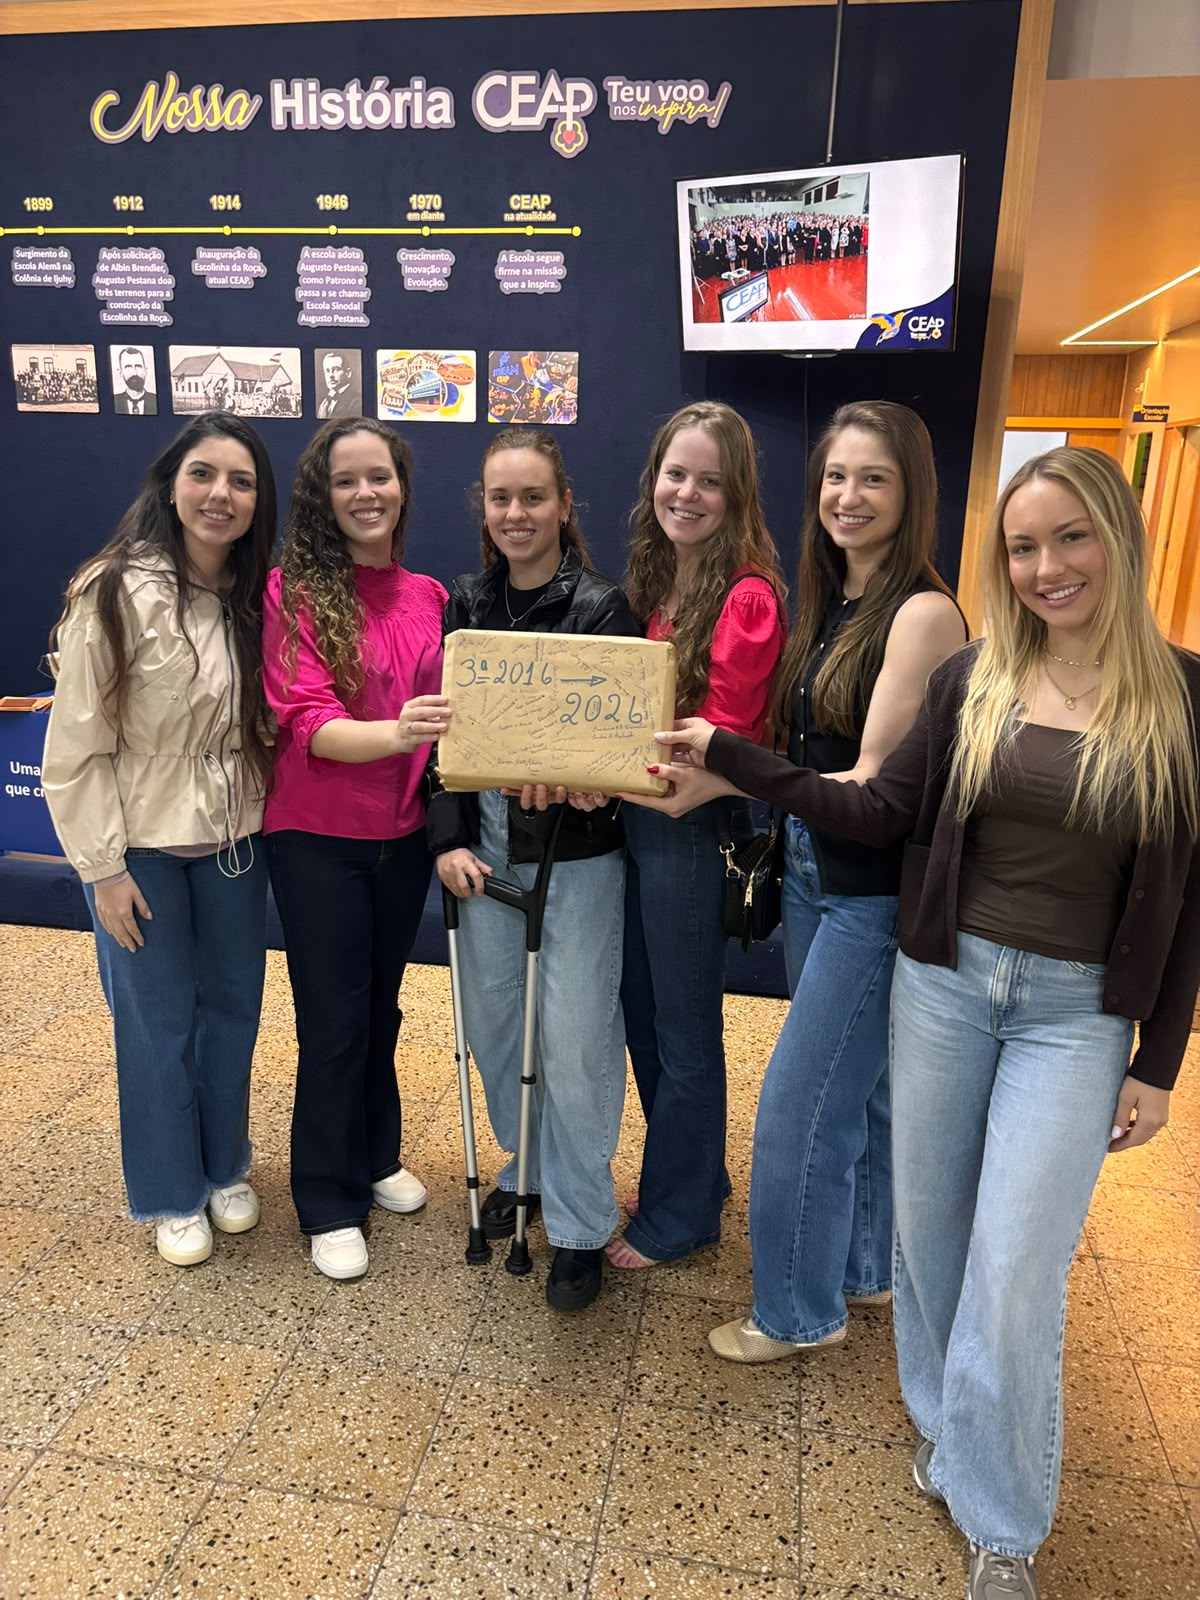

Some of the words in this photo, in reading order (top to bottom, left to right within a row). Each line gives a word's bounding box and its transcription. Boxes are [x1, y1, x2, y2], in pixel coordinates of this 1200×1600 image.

[607, 81, 650, 102] Teu
[658, 84, 705, 102] voo
[92, 74, 261, 141] Nossa
[273, 79, 452, 126] História
[475, 74, 594, 132] CEAP
[613, 105, 637, 115] nos
[638, 86, 728, 130] inspira!
[24, 197, 53, 211] 1899
[113, 195, 144, 211] 1912
[209, 194, 241, 211] 1914
[316, 194, 348, 210] 1946
[409, 194, 442, 210] 1970
[509, 194, 551, 210] CEAP
[406, 212, 420, 221] em
[421, 211, 445, 221] diante
[503, 213, 515, 221] na
[516, 211, 556, 221] atualidade
[15, 249, 57, 259] Surgimento
[59, 250, 68, 258] da
[102, 250, 121, 260] Após
[122, 251, 162, 261] solicitação
[199, 250, 246, 260] Inauguração
[247, 250, 258, 259] da
[303, 250, 310, 259] A
[311, 250, 336, 259] escola
[337, 250, 361, 259] adota
[400, 252, 452, 262] Crescimento,
[500, 254, 508, 263] A
[509, 254, 535, 263] Escola
[535, 255, 560, 264] segue
[14, 262, 37, 270] Escola
[38, 262, 61, 270] Alemã
[99, 263, 109, 271] de
[111, 263, 131, 272] Albin
[194, 263, 230, 272] Escolinha
[231, 263, 242, 272] da
[242, 263, 264, 273] Roça,
[300, 263, 332, 273] Augusto
[333, 263, 365, 272] Pestana
[405, 265, 441, 275] Inovação
[498, 267, 520, 276] firme
[533, 267, 563, 276] missão
[14, 274, 42, 282] Colônia
[43, 274, 52, 282] de
[95, 276, 126, 286] Augusto
[126, 276, 156, 285] Pestana
[157, 276, 173, 285] doa
[208, 276, 228, 284] atual
[229, 276, 251, 285] CEAP.
[302, 277, 324, 285] como
[325, 276, 357, 285] Patrono
[407, 278, 446, 288] Evolução.
[503, 281, 519, 290] que
[98, 288, 113, 296] três
[114, 289, 146, 297] terrenos
[147, 291, 164, 299] para
[298, 290, 320, 299] passa
[338, 289, 368, 298] chamar
[726, 281, 766, 312] CEAP
[109, 301, 150, 311] construção
[151, 301, 161, 310] da
[306, 301, 330, 310] Escola
[331, 302, 361, 311] Sinodal
[102, 313, 137, 321] Escolinha
[138, 313, 148, 322] da
[149, 314, 170, 323] Roça.
[300, 314, 332, 324] Augusto
[333, 314, 367, 323] Pestana.
[908, 316, 945, 332] CEAP
[492, 658, 553, 687] 2016
[560, 691, 643, 726] 2026
[10, 760, 41, 776] Uma
[5, 784, 30, 797] que
[33, 787, 45, 798] cr
